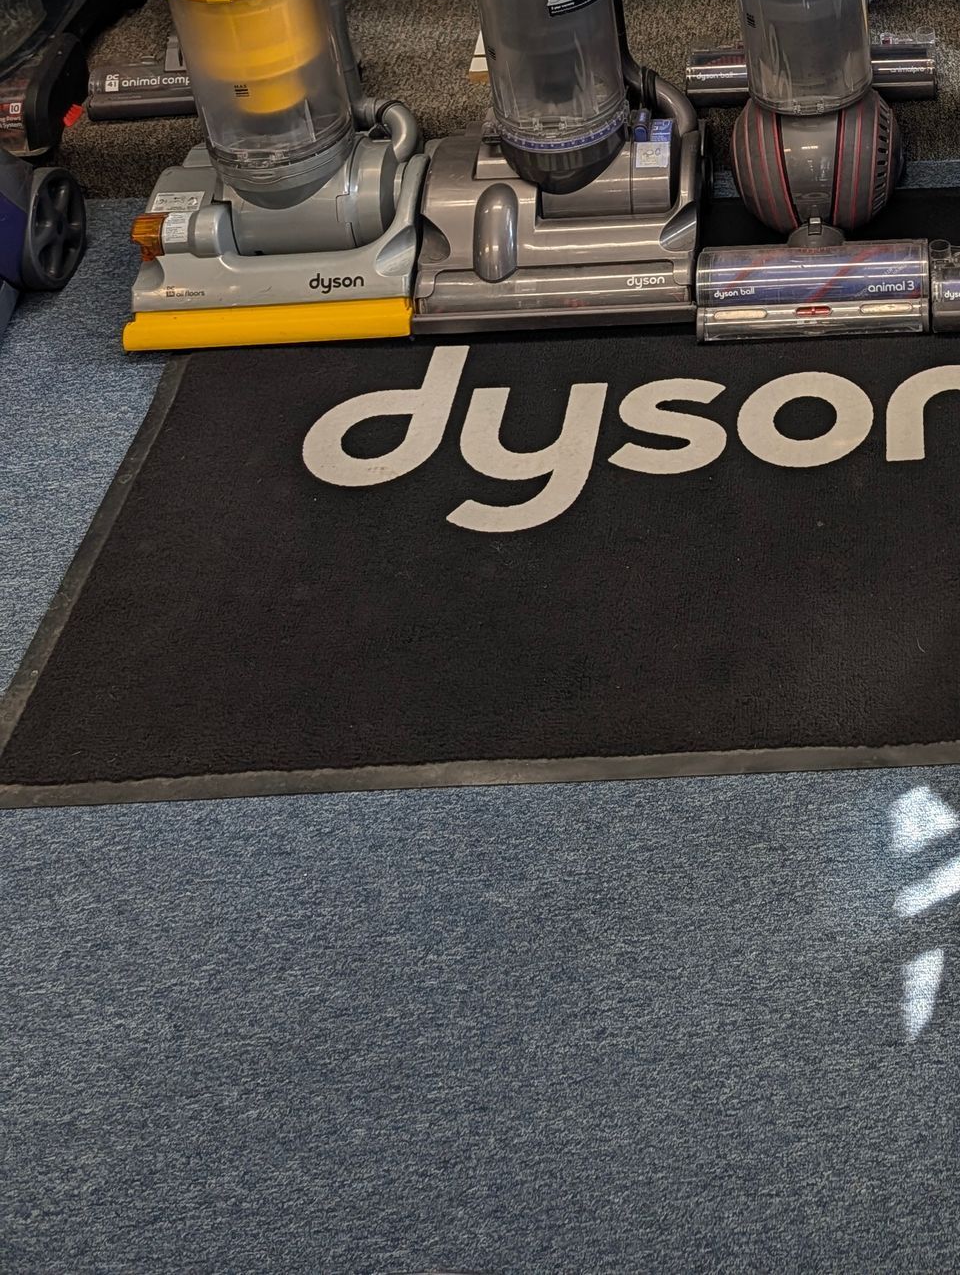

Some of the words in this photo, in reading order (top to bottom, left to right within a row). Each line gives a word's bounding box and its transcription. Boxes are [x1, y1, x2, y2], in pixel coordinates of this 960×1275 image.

[890, 65, 925, 73] animalpro
[121, 76, 160, 87] animal
[309, 273, 364, 293] dyson
[627, 275, 665, 289] dyson
[868, 281, 906, 293] animal
[714, 288, 738, 299] dyson
[740, 287, 755, 297] ball
